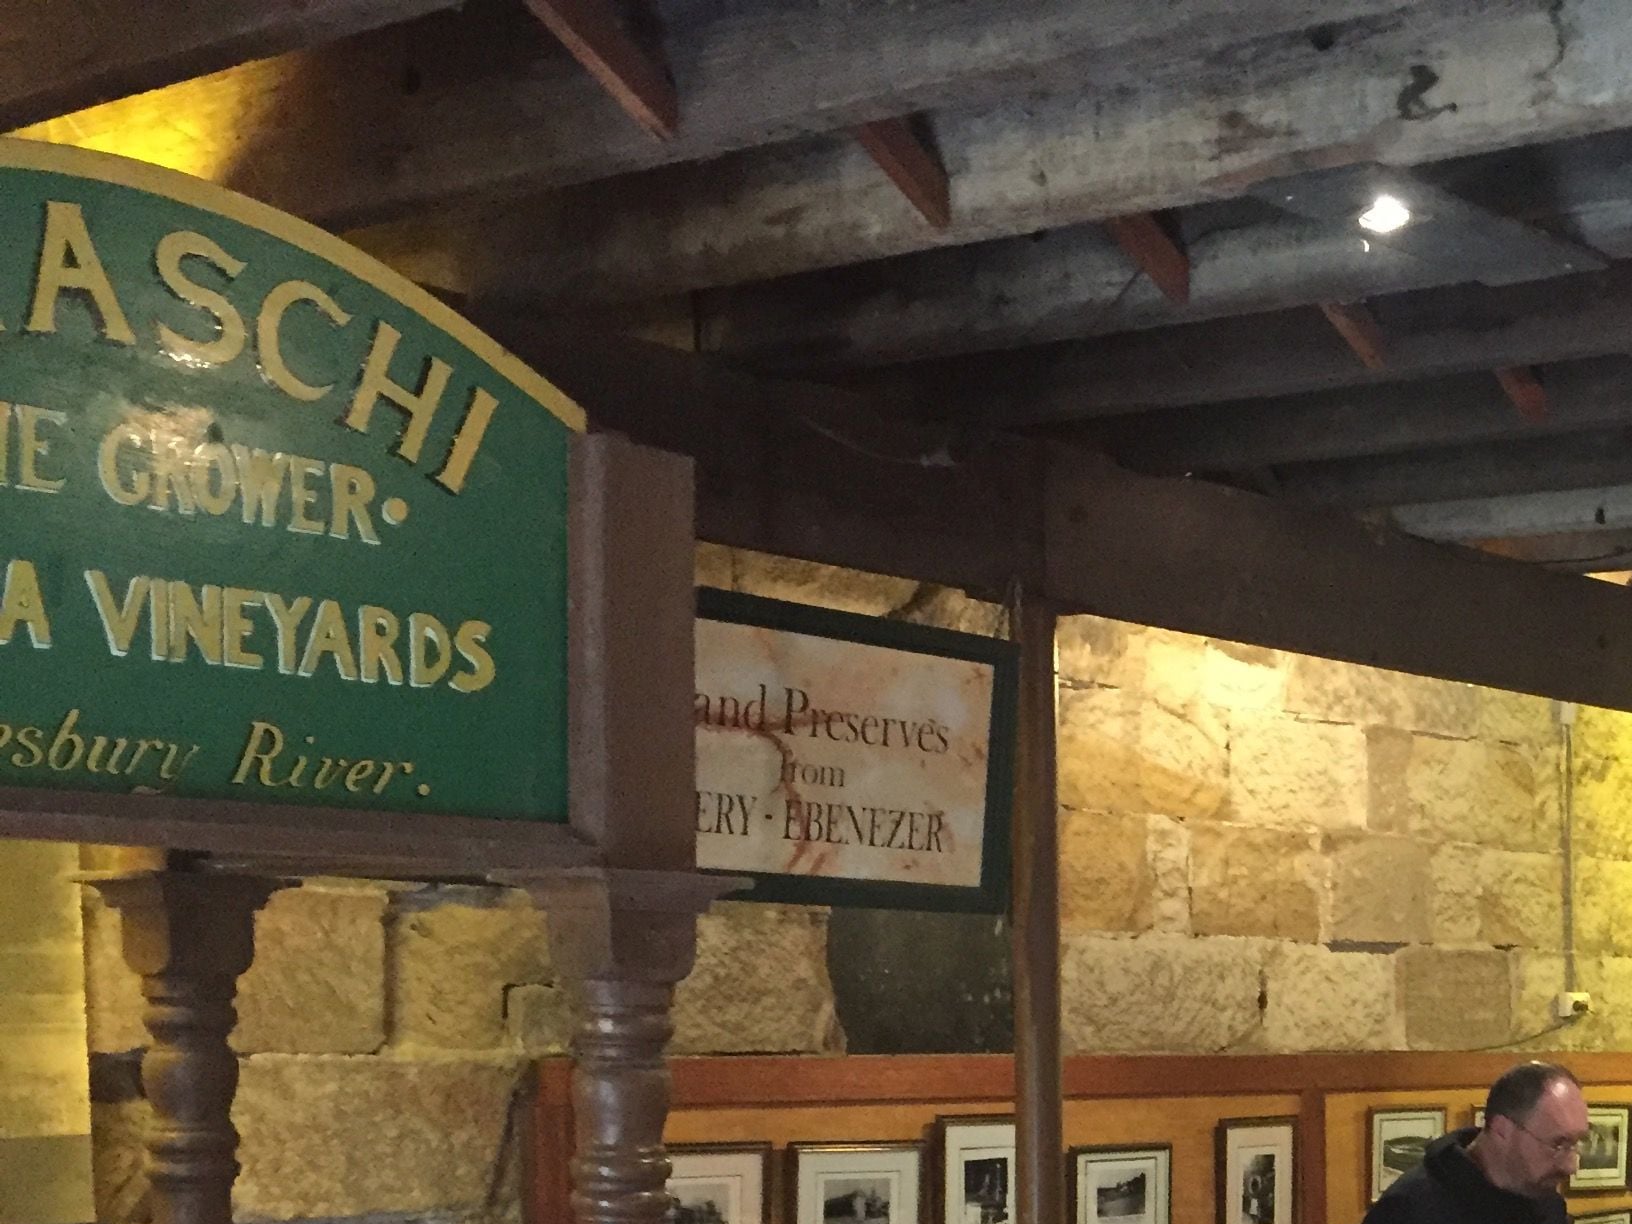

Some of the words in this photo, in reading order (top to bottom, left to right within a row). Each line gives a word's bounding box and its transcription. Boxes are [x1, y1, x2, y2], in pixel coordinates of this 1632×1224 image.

[0, 200, 499, 496] ASCHI
[0, 559, 52, 650] A
[85, 569, 497, 694] VINEYARDS
[695, 683, 766, 731] and
[784, 687, 950, 753] Preserves
[233, 721, 431, 798] River.
[783, 800, 945, 852] EBENEZER
